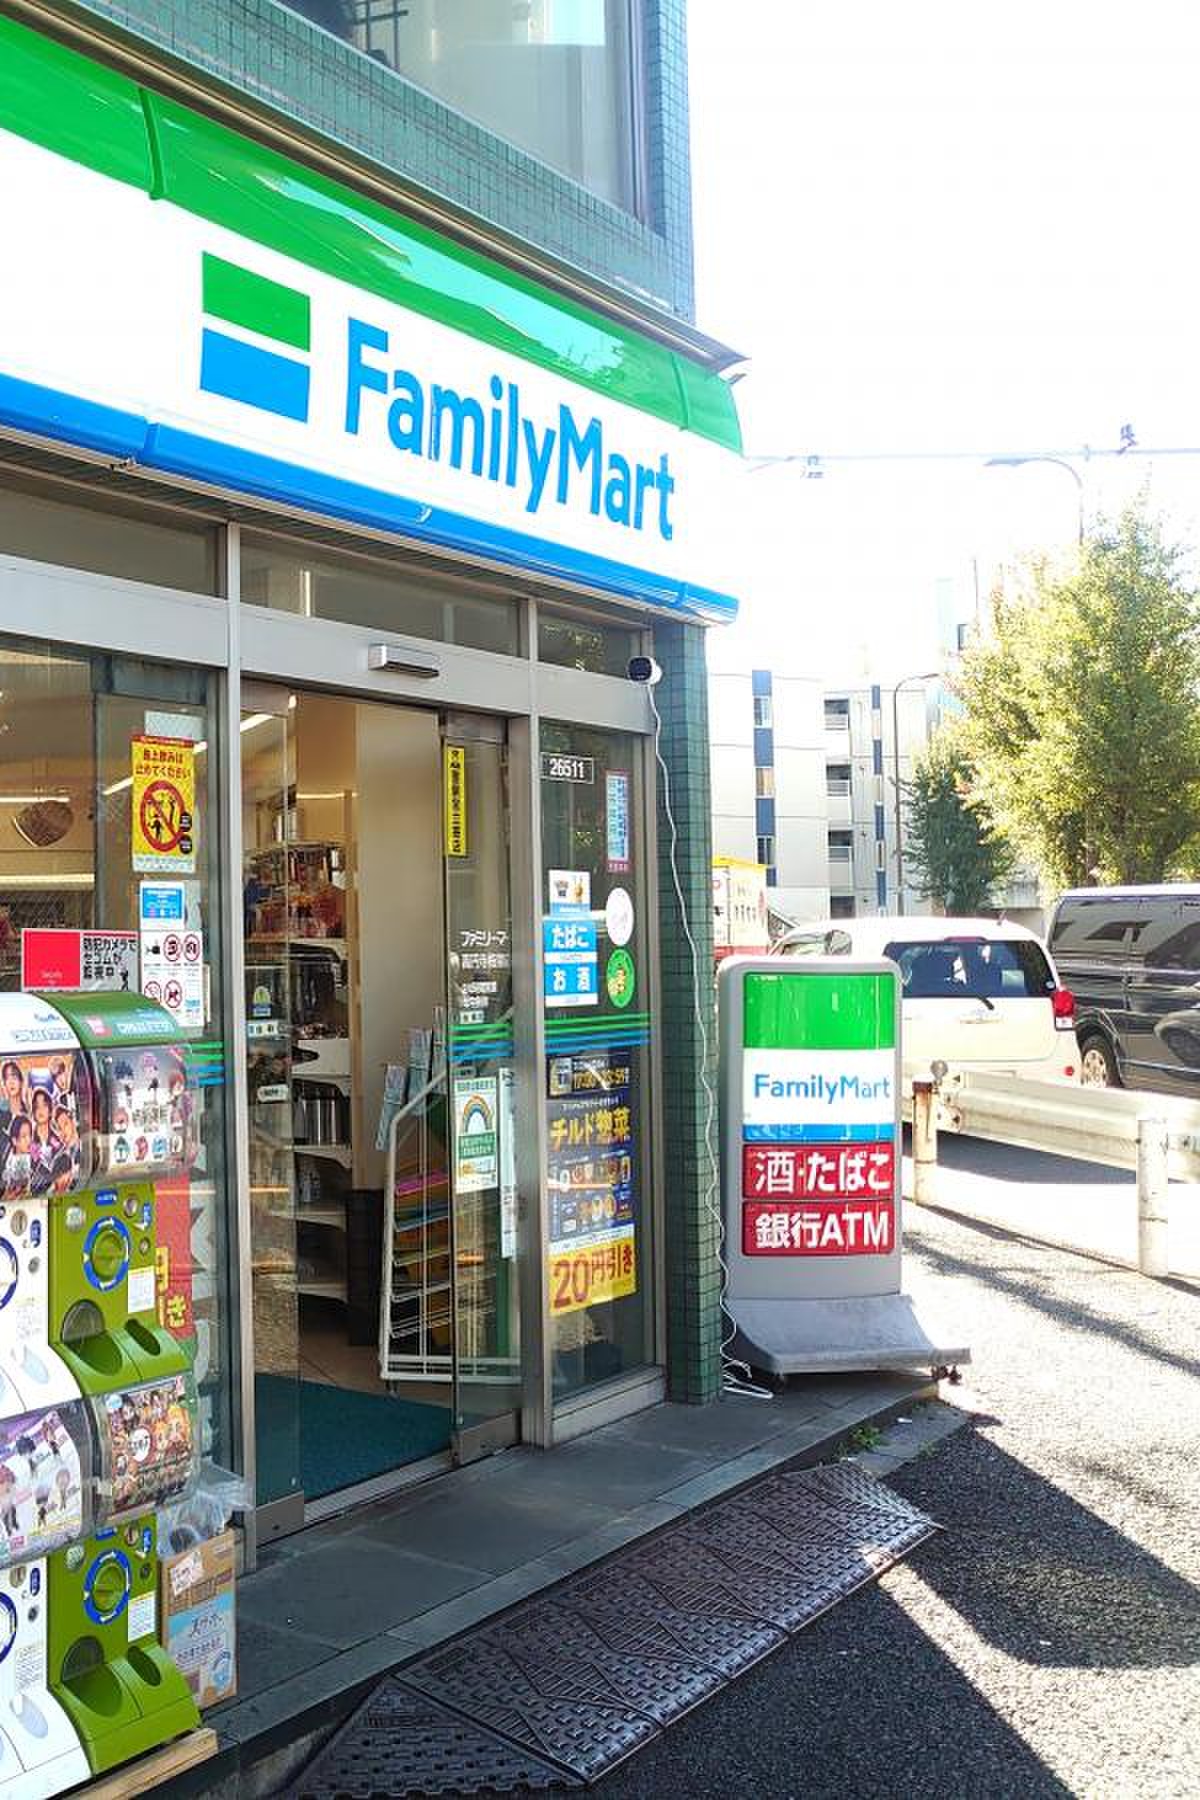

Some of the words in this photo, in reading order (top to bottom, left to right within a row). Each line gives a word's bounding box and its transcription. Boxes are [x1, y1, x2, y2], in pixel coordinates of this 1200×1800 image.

[345, 317, 675, 540] FamilyMart
[550, 758, 584, 779] 26511
[754, 1073, 890, 1104] FamilyMart
[755, 1151, 891, 1194] 酒・たばこ
[755, 1212, 889, 1250] 銀行ATM
